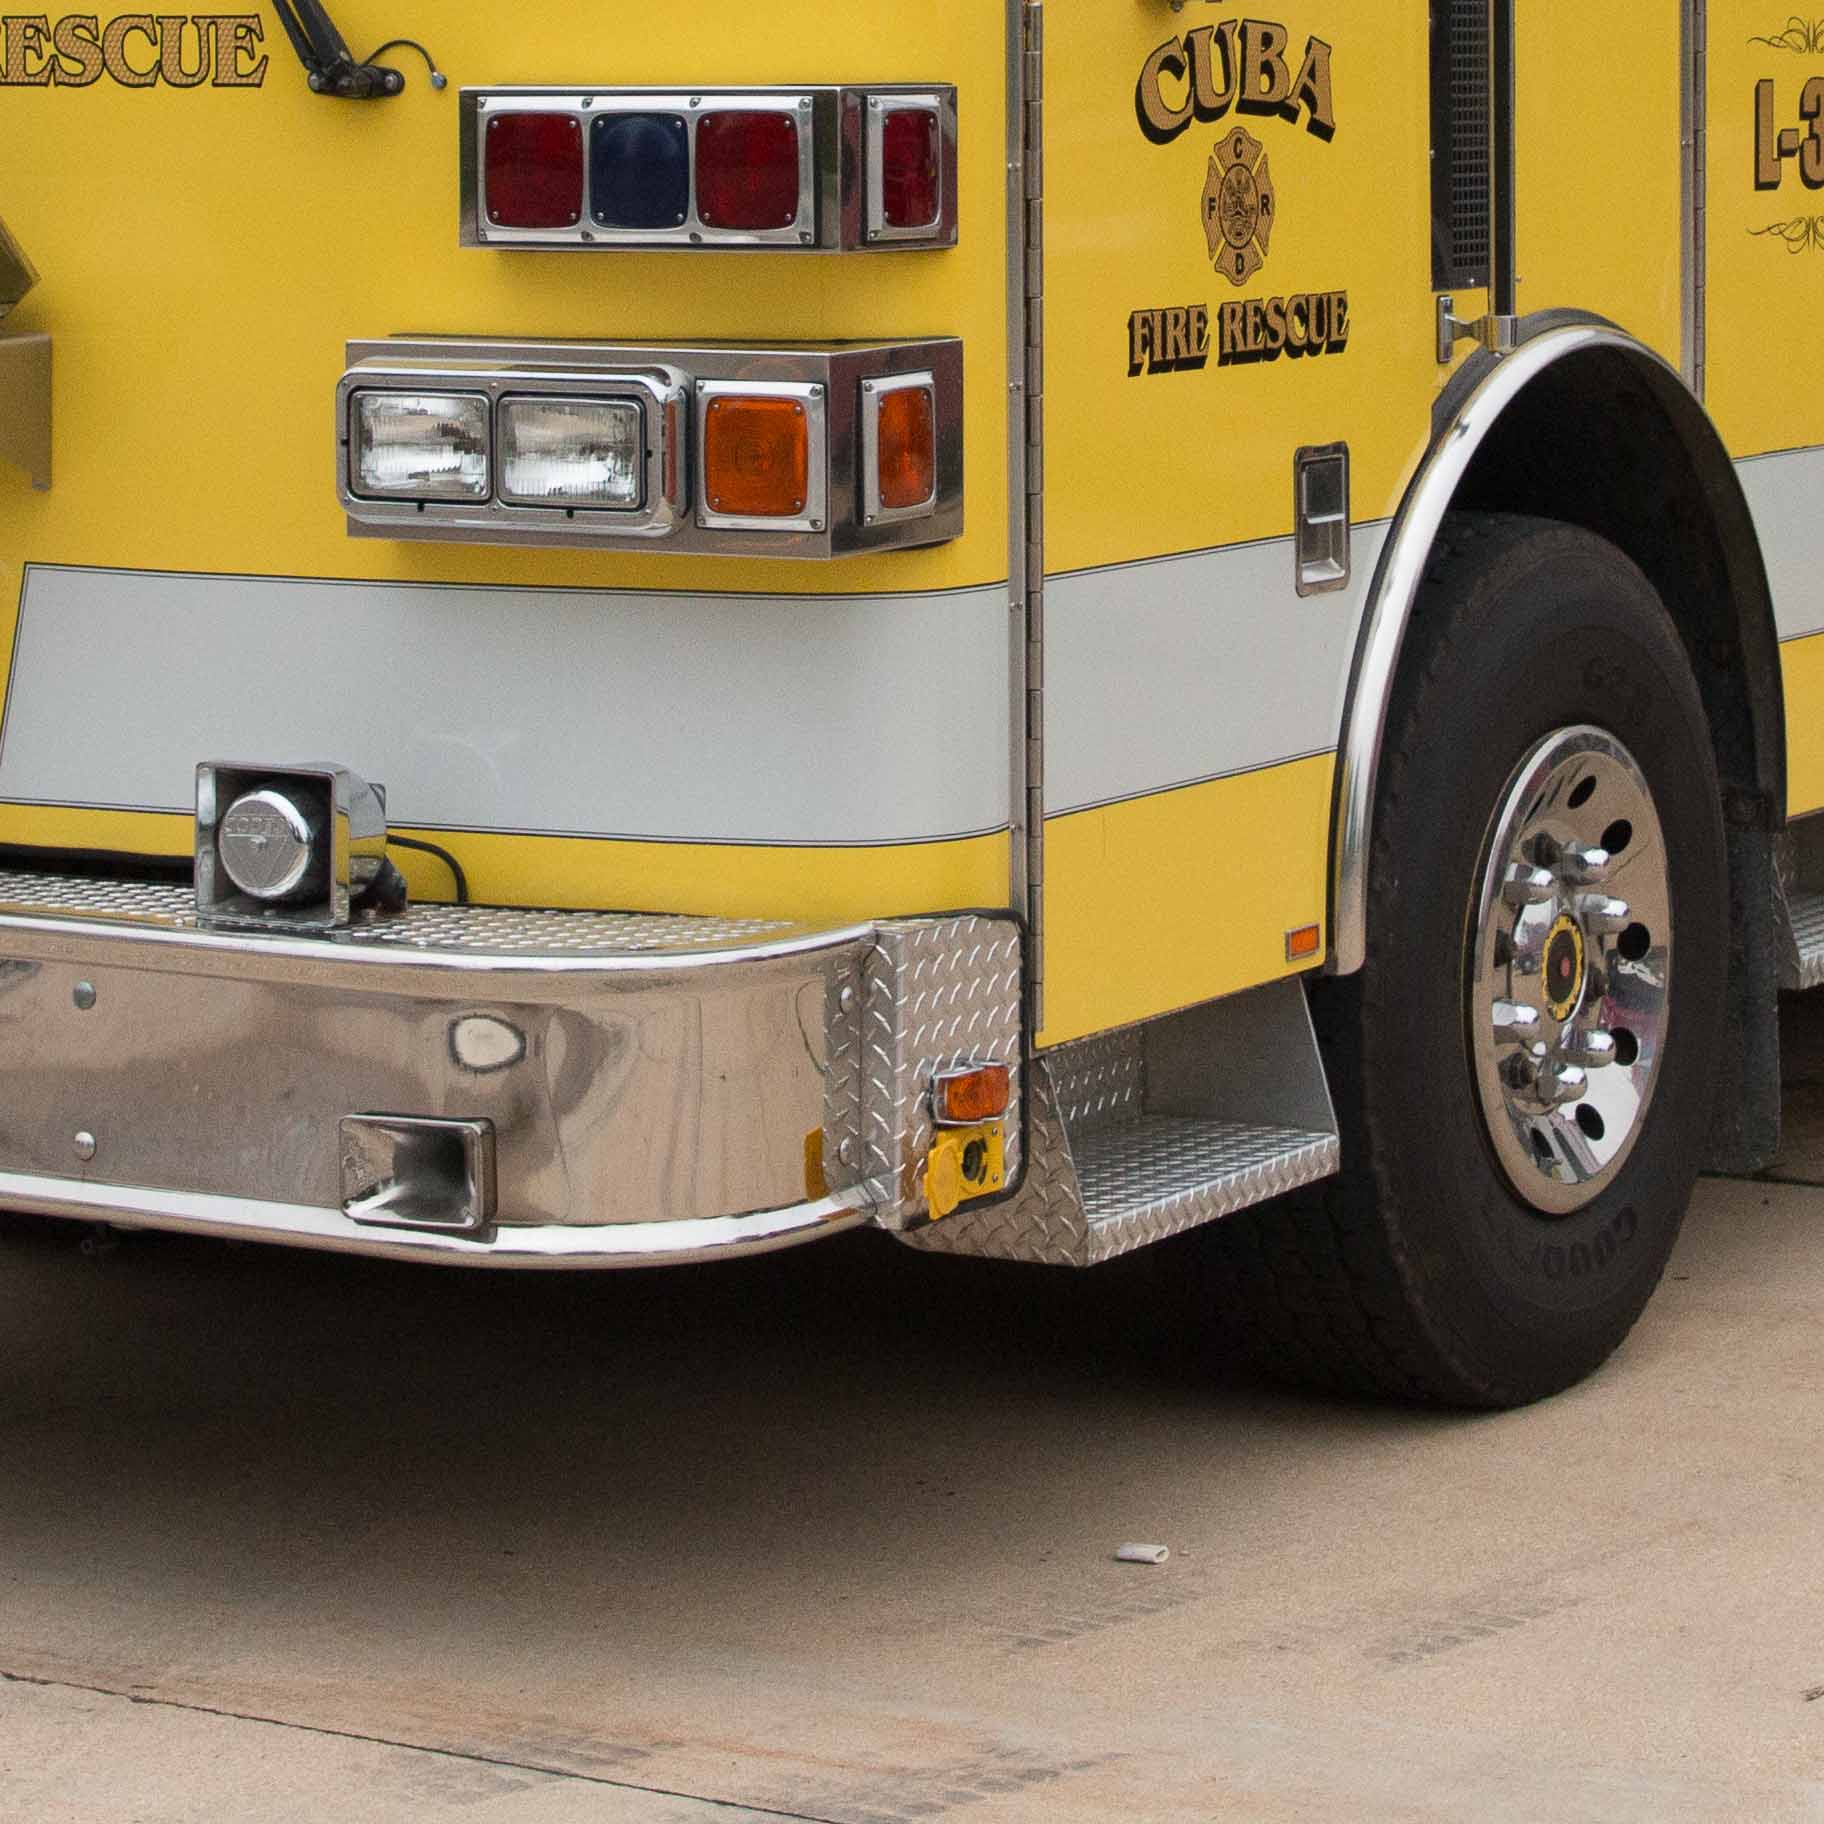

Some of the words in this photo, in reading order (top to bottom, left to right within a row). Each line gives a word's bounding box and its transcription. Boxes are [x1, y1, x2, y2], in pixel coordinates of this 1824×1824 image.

[1135, 19, 1336, 145] CUBA
[1233, 137, 1243, 159] C
[1207, 197, 1217, 219] F
[1260, 193, 1270, 216] R
[1235, 253, 1245, 274] D
[1127, 302, 1211, 378] FIRE
[1217, 289, 1350, 367] RESCUE
